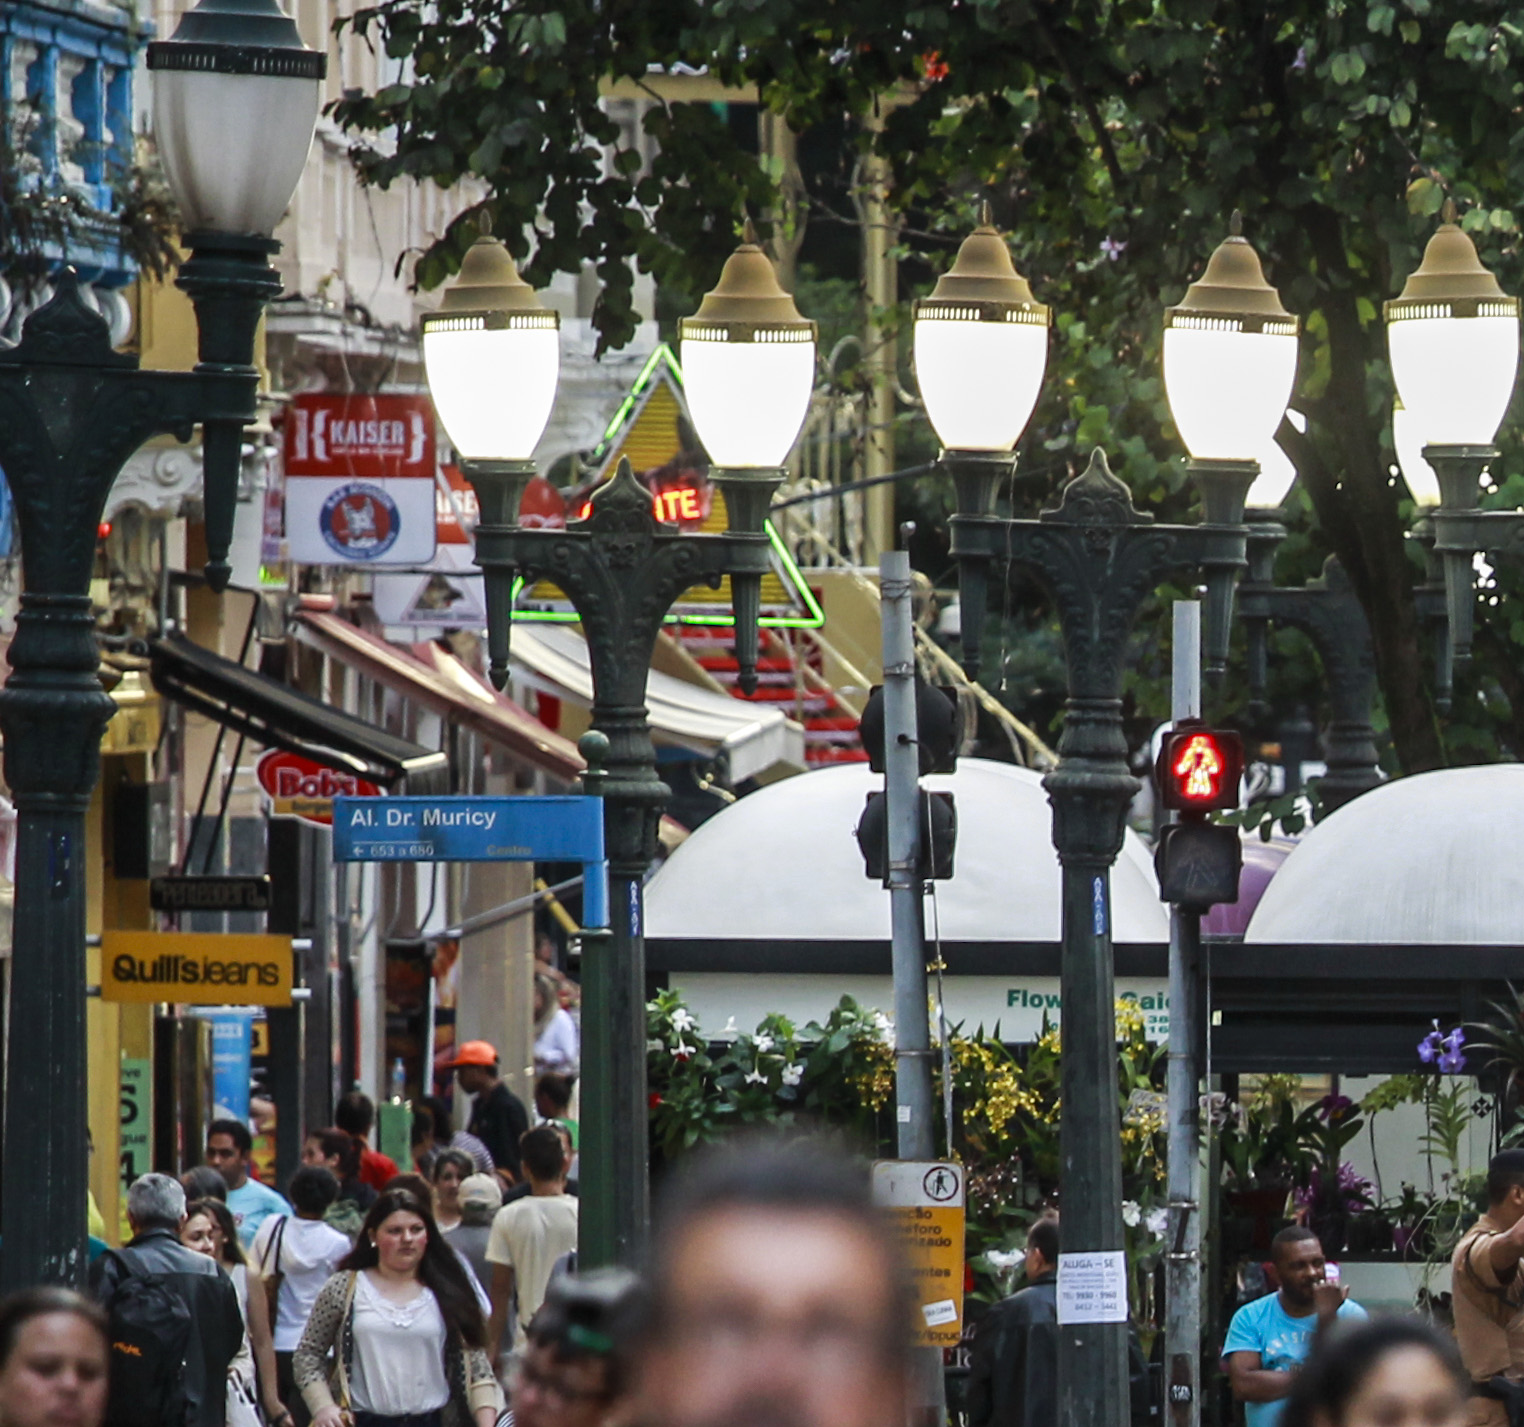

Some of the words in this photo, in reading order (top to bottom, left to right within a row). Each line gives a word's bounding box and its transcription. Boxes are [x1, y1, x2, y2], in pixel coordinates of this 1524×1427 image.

[331, 420, 405, 445] KAISER
[437, 489, 479, 516] AISE
[653, 488, 701, 523] ITE
[277, 767, 357, 798] Bob's
[351, 808, 379, 827] Al.
[386, 808, 416, 827] Dr.
[422, 808, 497, 830] Muricy
[200, 956, 280, 987] jeans
[1007, 989, 1062, 1008] Flow
[1063, 1260, 1093, 1269] ALUGA
